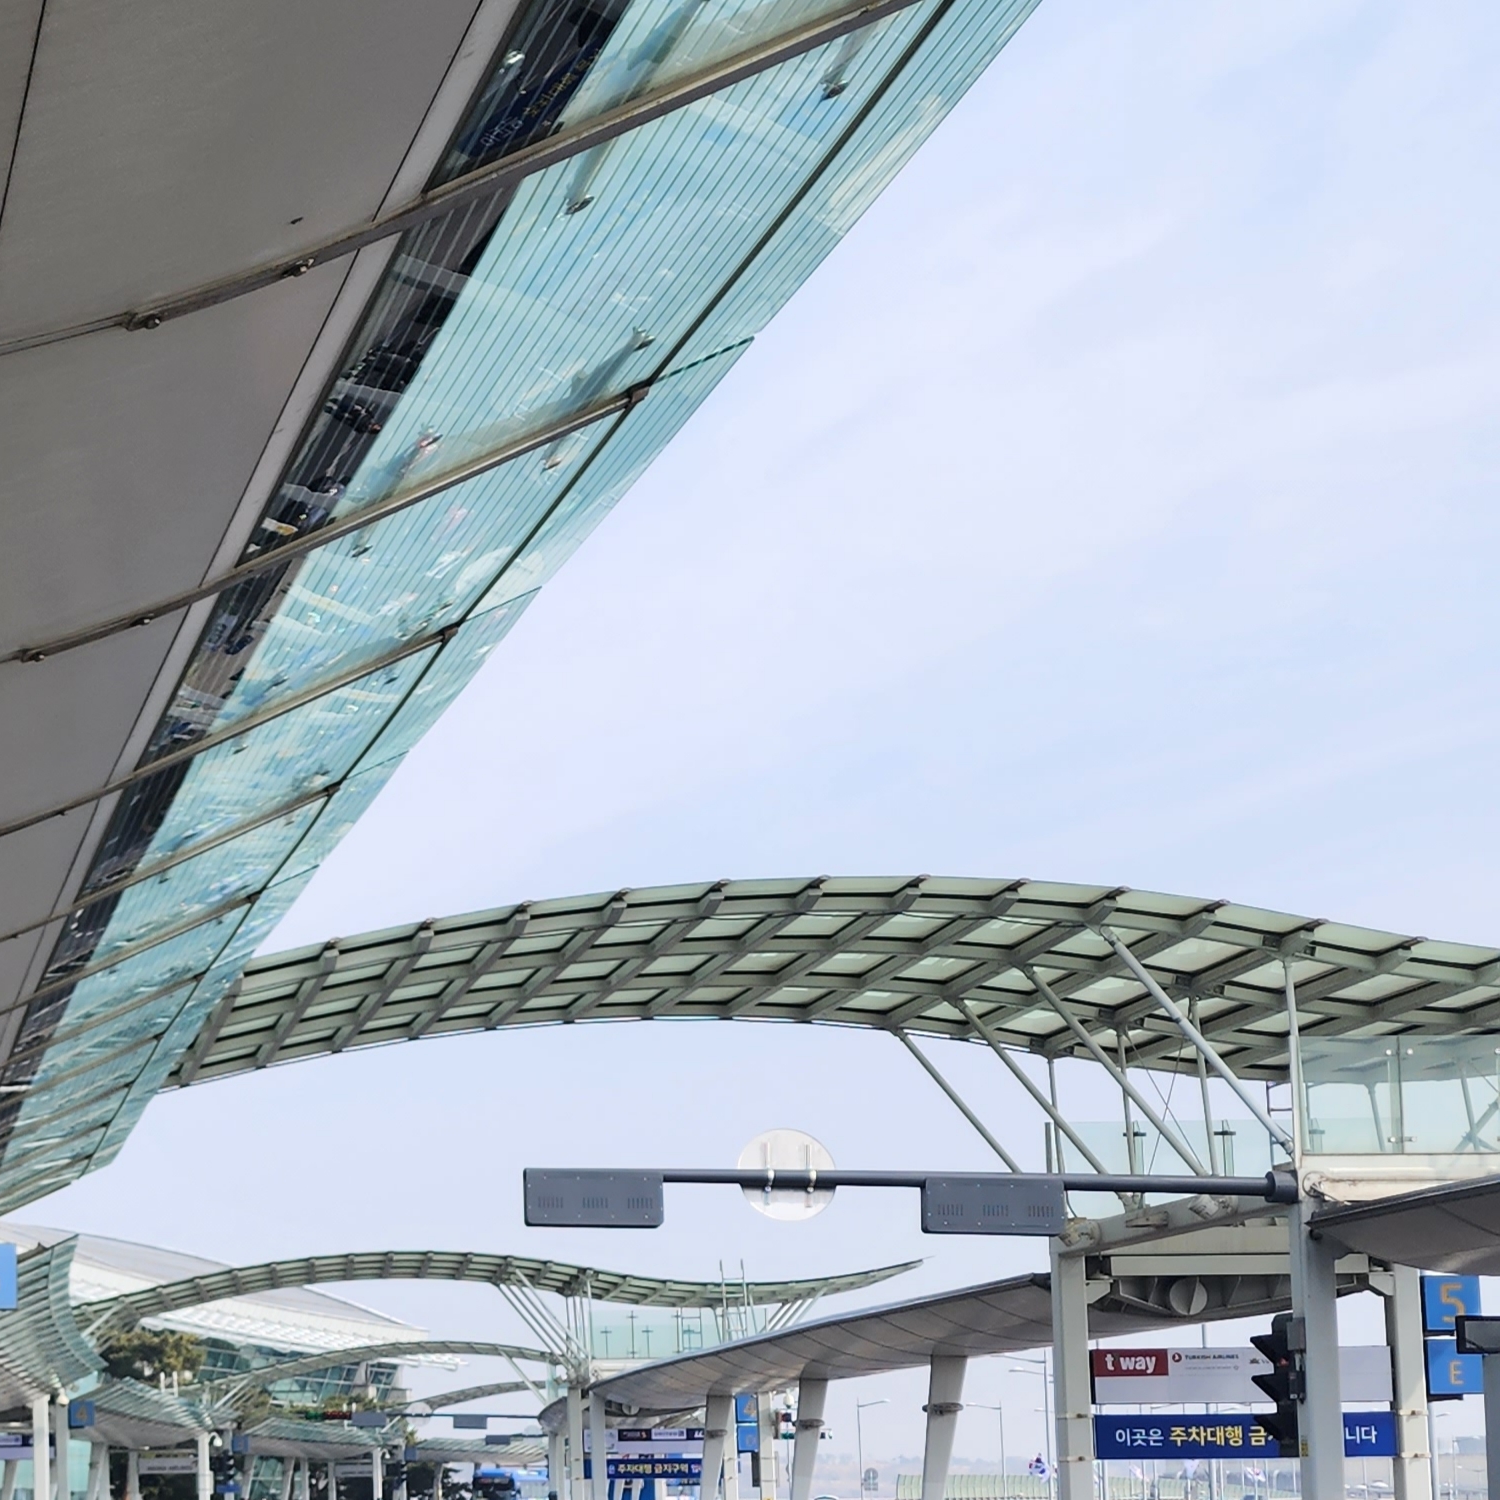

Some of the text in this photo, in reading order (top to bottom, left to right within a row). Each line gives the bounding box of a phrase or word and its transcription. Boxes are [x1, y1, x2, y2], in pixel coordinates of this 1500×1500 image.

[1441, 1283, 1465, 1323] 5
[1449, 1361, 1464, 1385] E
[1115, 1428, 1165, 1447] 이곳은
[1169, 1425, 1243, 1447] 주차대행
